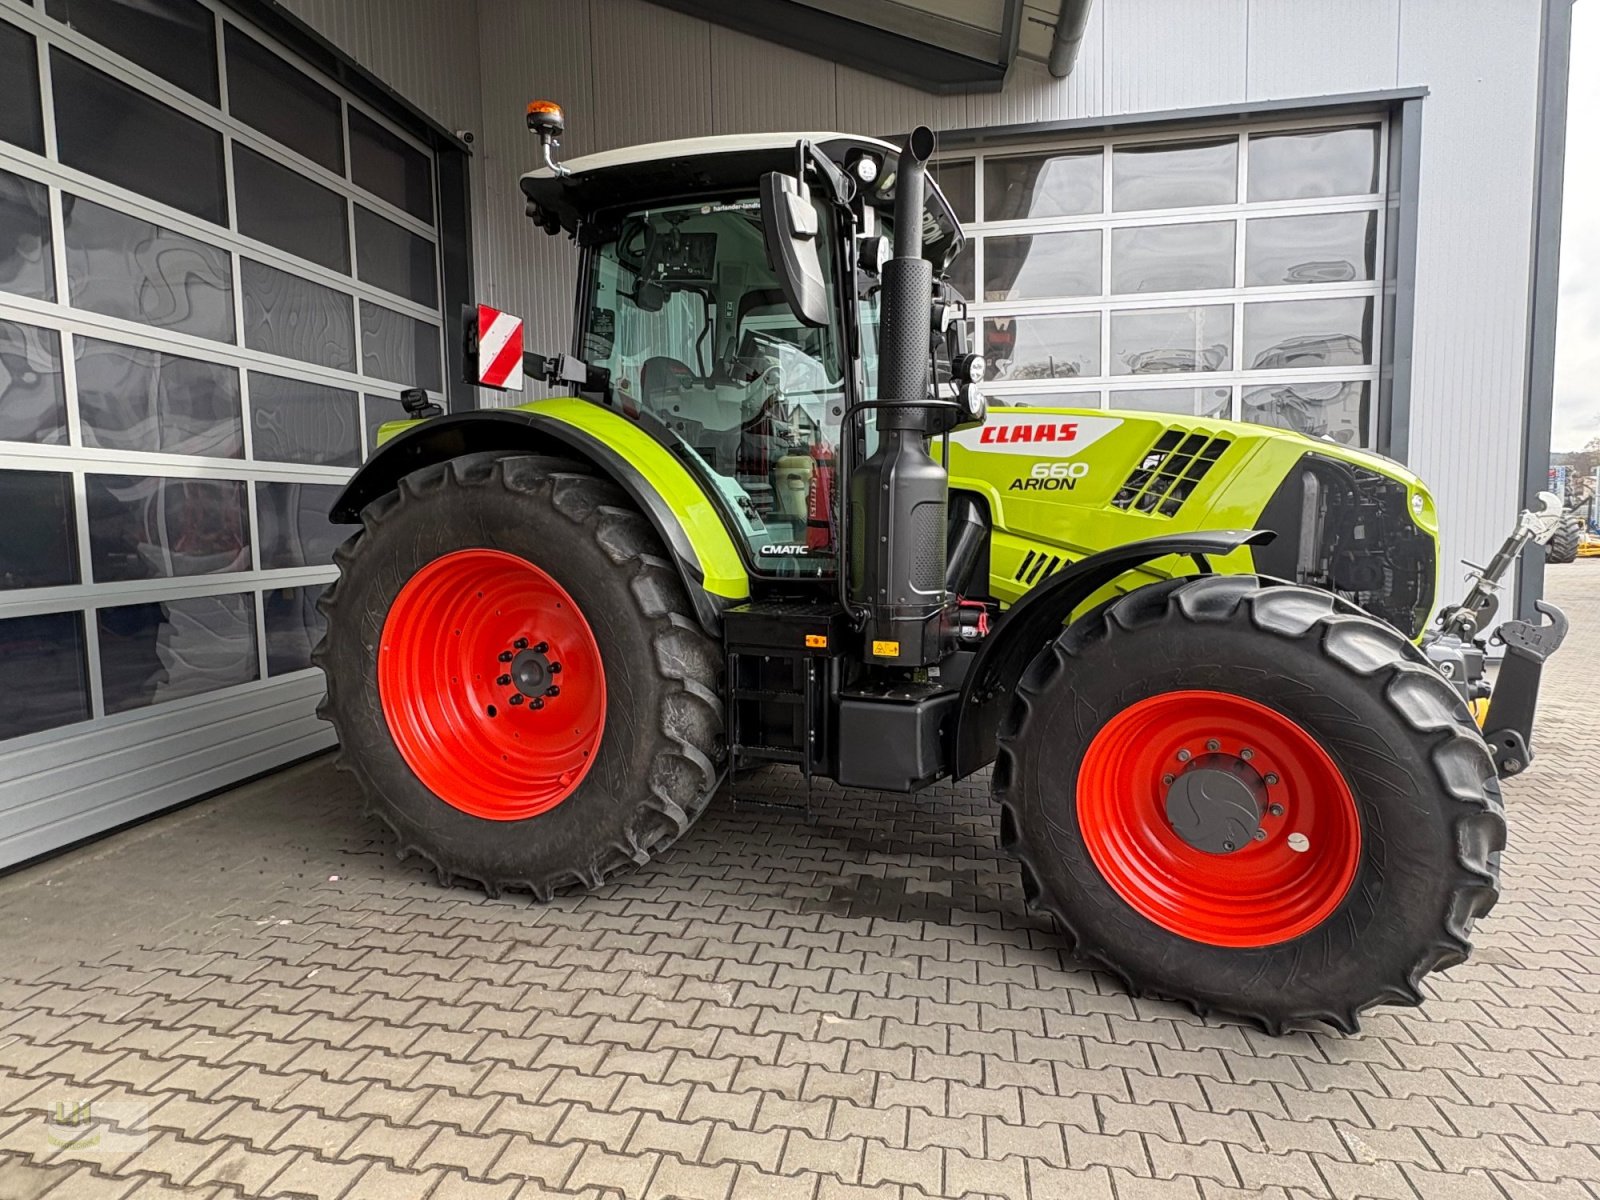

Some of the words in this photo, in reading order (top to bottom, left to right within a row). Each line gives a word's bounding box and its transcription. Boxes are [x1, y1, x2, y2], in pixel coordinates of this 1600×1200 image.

[922, 206, 945, 246] RION
[980, 423, 1078, 444] CLAAS
[1031, 462, 1089, 478] 660
[1009, 478, 1077, 491] ARION
[761, 545, 809, 555] CMATIC
